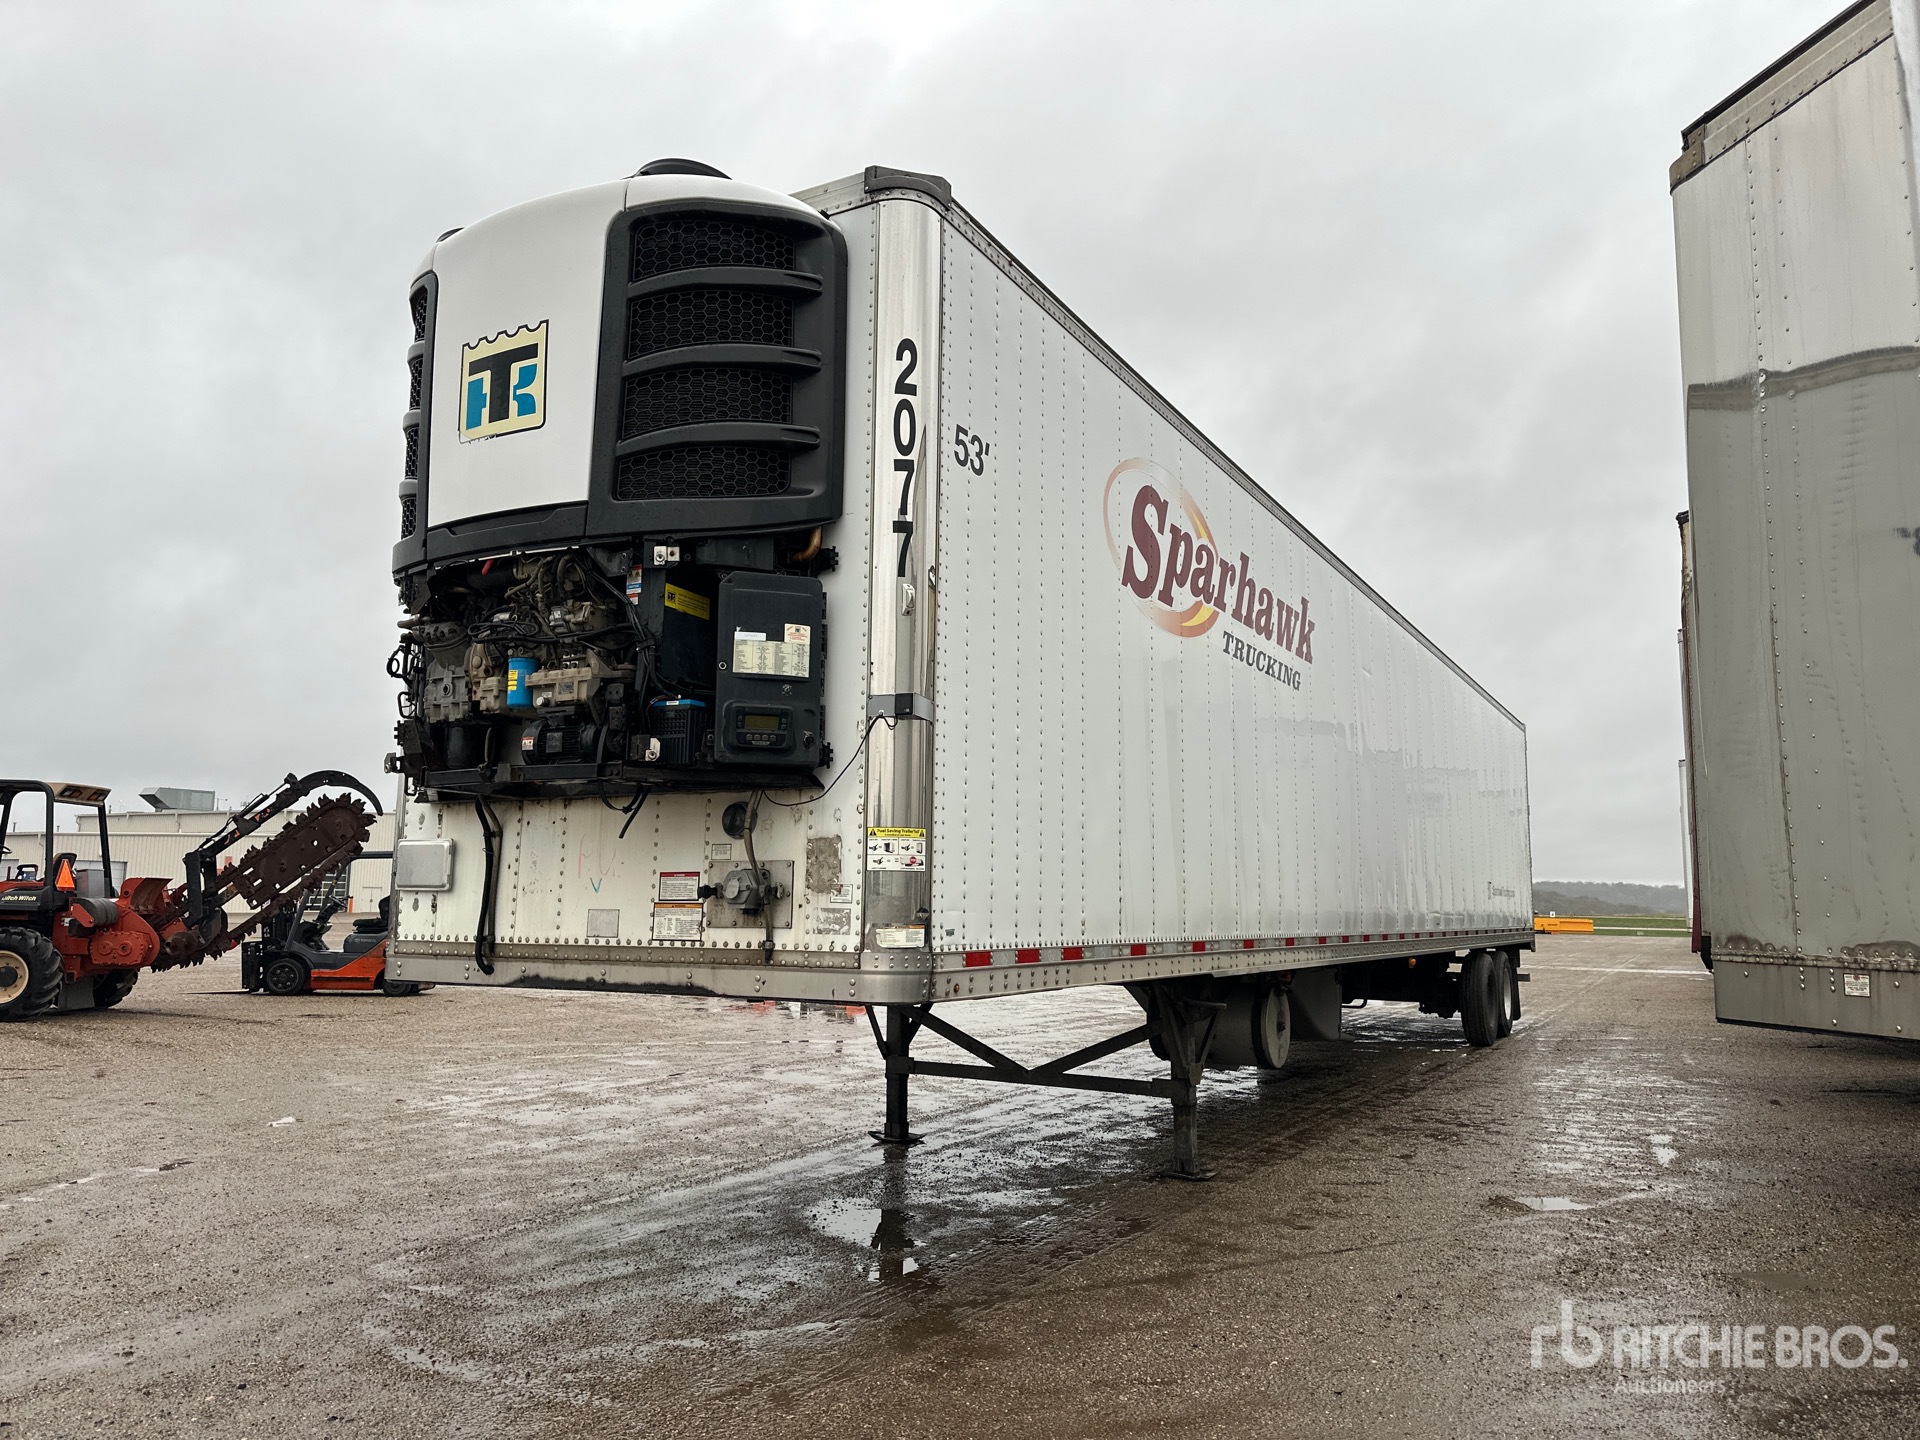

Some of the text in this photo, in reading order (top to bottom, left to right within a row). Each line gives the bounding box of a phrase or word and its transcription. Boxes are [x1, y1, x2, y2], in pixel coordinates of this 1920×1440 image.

[892, 337, 918, 578] 2077
[953, 423, 990, 477] 53'
[1121, 484, 1315, 665] Sparhawk
[1222, 630, 1301, 691] TRUCKING
